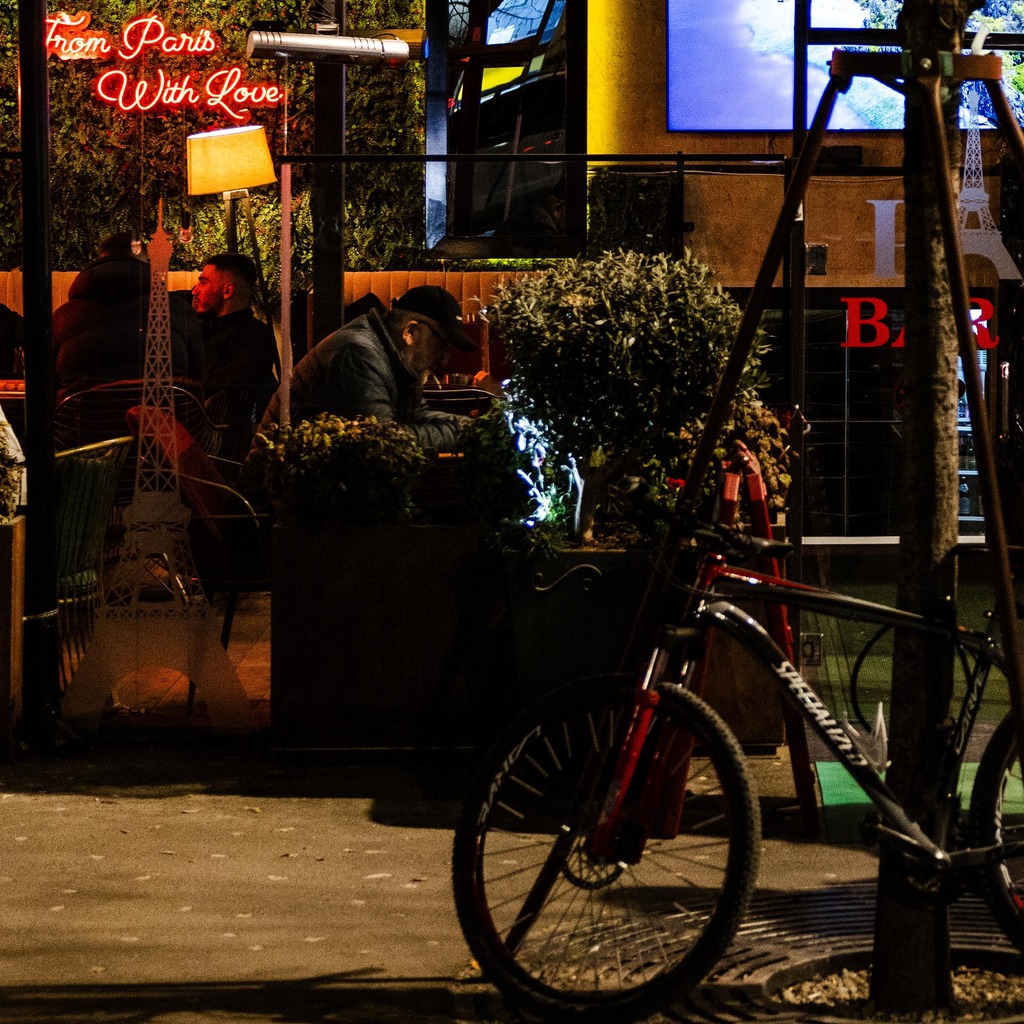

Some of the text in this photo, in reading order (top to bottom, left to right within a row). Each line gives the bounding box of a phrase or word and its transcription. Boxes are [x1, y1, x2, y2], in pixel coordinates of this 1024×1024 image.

[46, 14, 215, 60] From Paris
[97, 67, 281, 119] With Love
[840, 296, 1000, 349] BR
